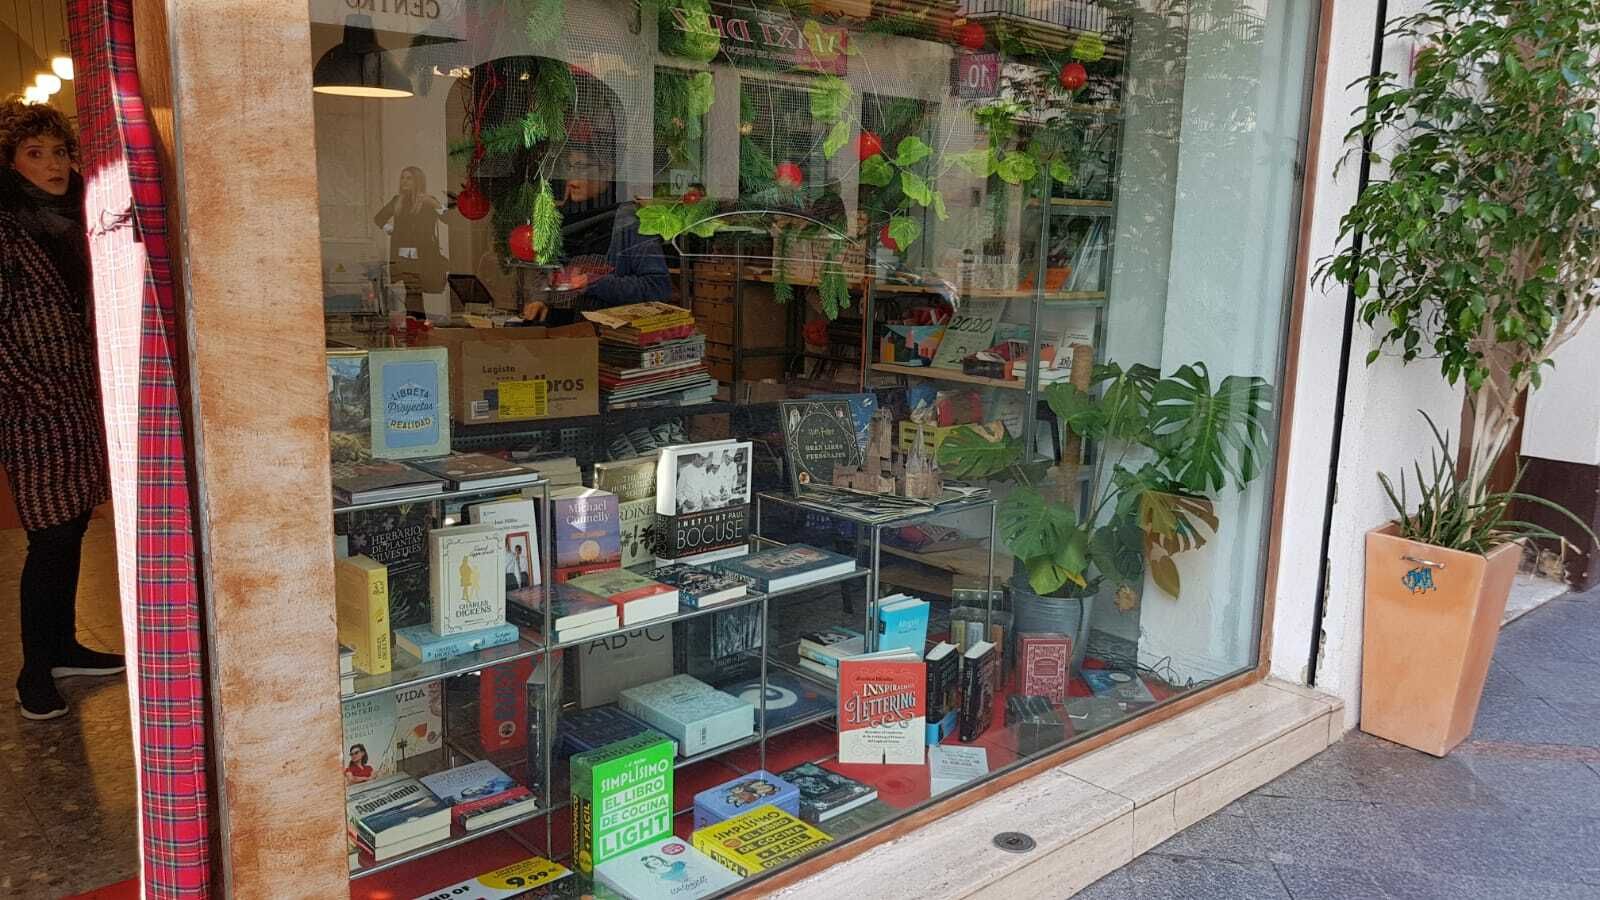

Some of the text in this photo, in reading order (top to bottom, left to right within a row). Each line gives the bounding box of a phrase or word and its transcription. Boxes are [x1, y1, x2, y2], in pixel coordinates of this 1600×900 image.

[948, 315, 993, 334] 2020
[391, 387, 430, 401] LIBRETA
[390, 417, 432, 430] REALIDAD
[568, 499, 608, 513] Michael
[566, 511, 611, 525] Connelly
[677, 511, 744, 529] INSTITUT PAUL
[371, 525, 421, 546] HERBARIO
[676, 519, 744, 550] BOCUSE
[455, 606, 492, 618] DICKENS
[395, 688, 426, 703] VIDA
[844, 690, 916, 724] LETTERING
[605, 778, 664, 811] EL LIBRO
[602, 796, 668, 828] DE COCINA
[600, 812, 669, 857] LIGHT
[760, 825, 805, 846] COCINA
[762, 855, 786, 869] DEL
